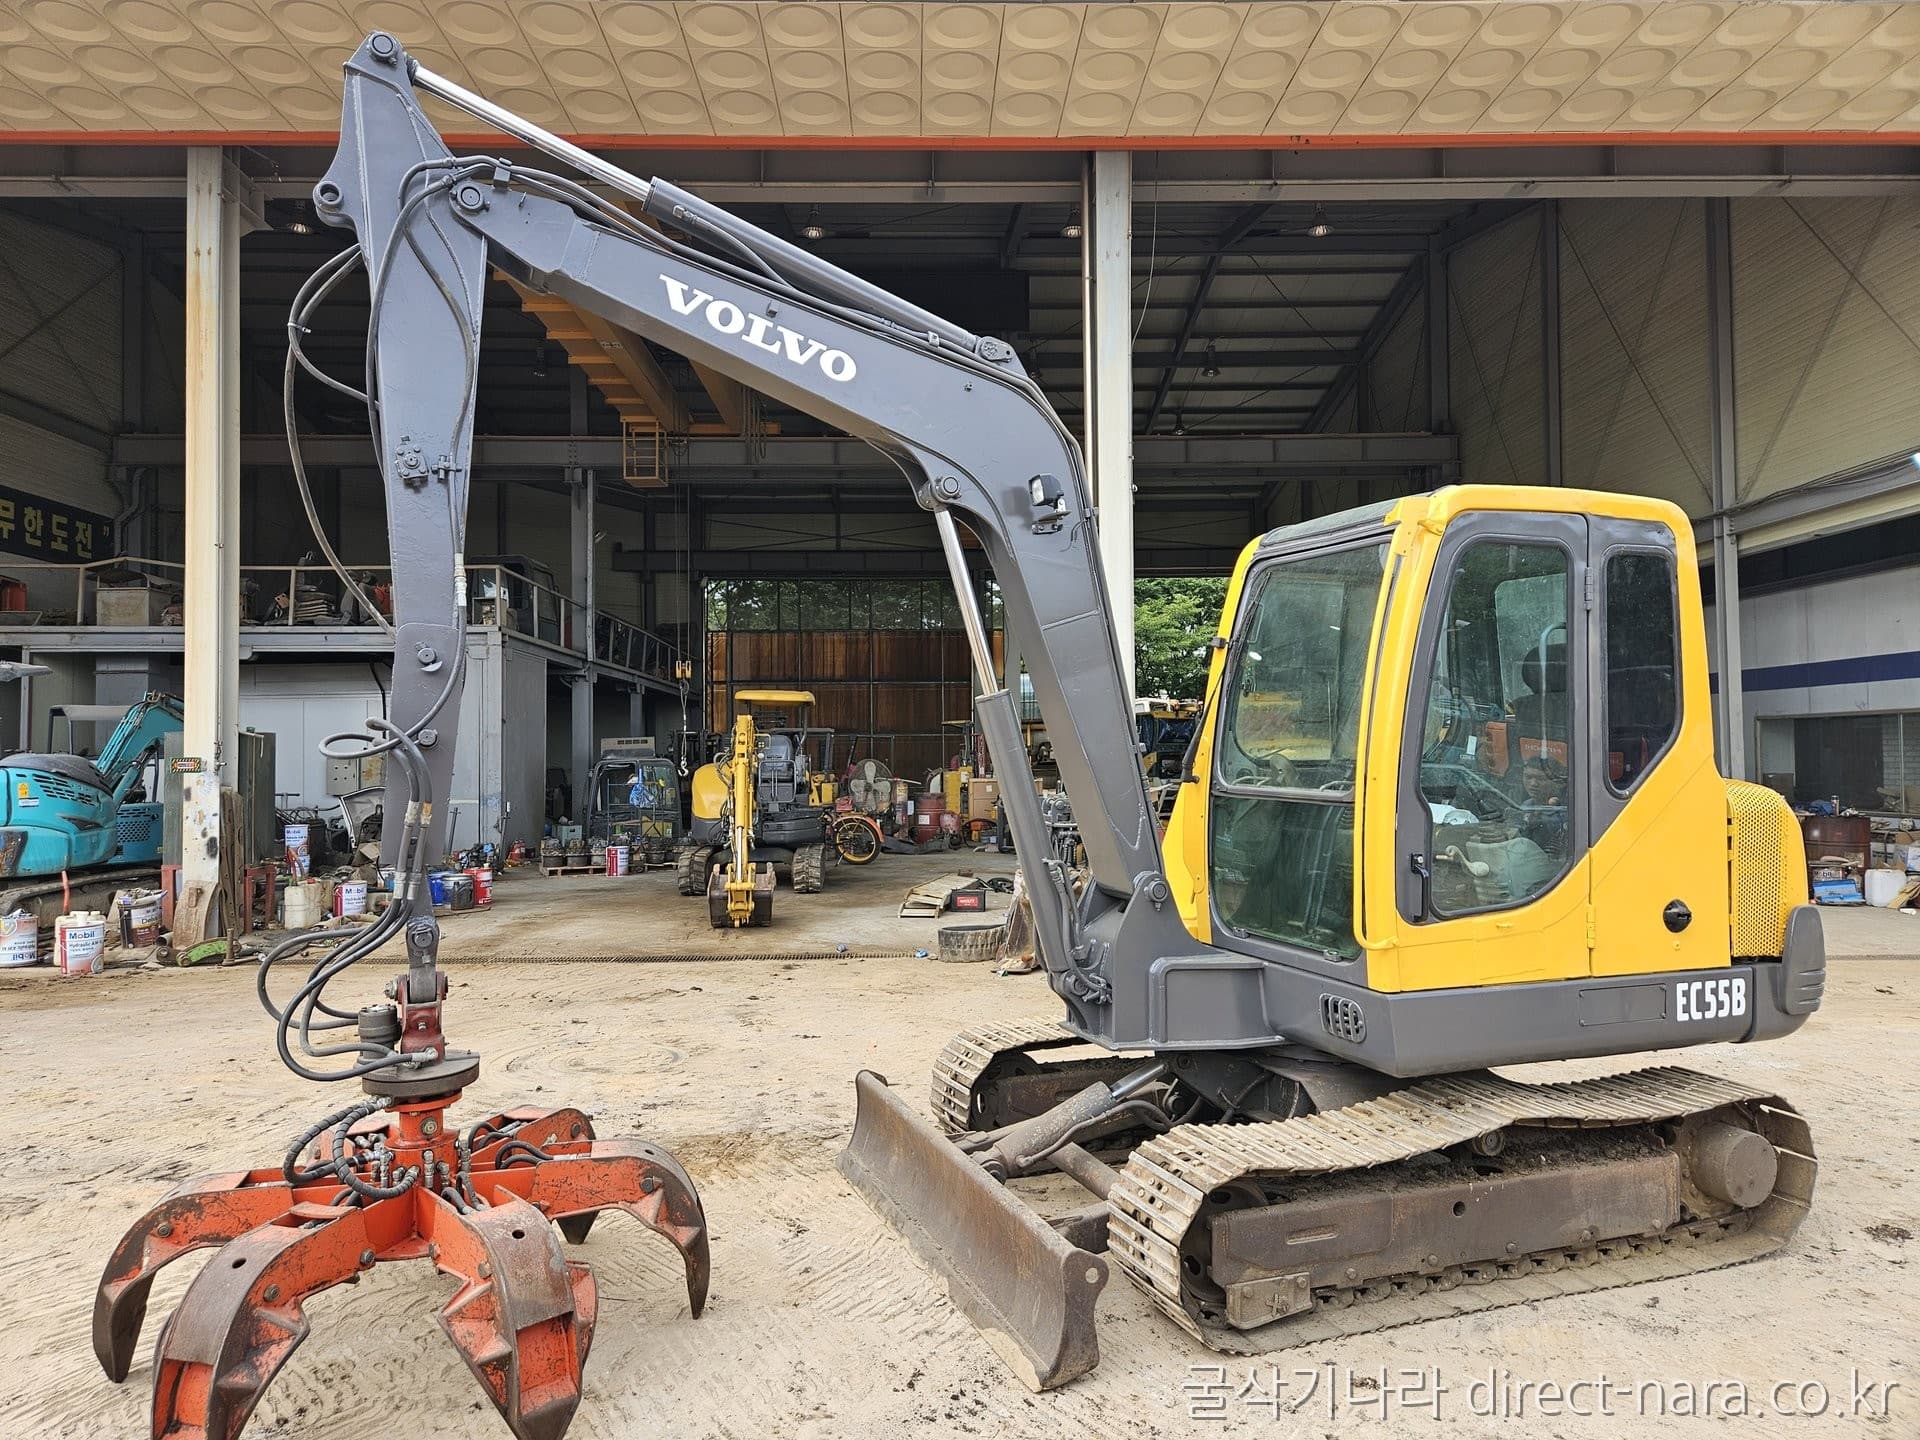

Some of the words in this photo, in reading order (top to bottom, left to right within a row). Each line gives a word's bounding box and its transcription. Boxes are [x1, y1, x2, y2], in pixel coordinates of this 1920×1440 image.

[659, 274, 857, 382] VOLVO
[69, 931, 95, 939] Mobil
[1676, 978, 1746, 1022] EC55B
